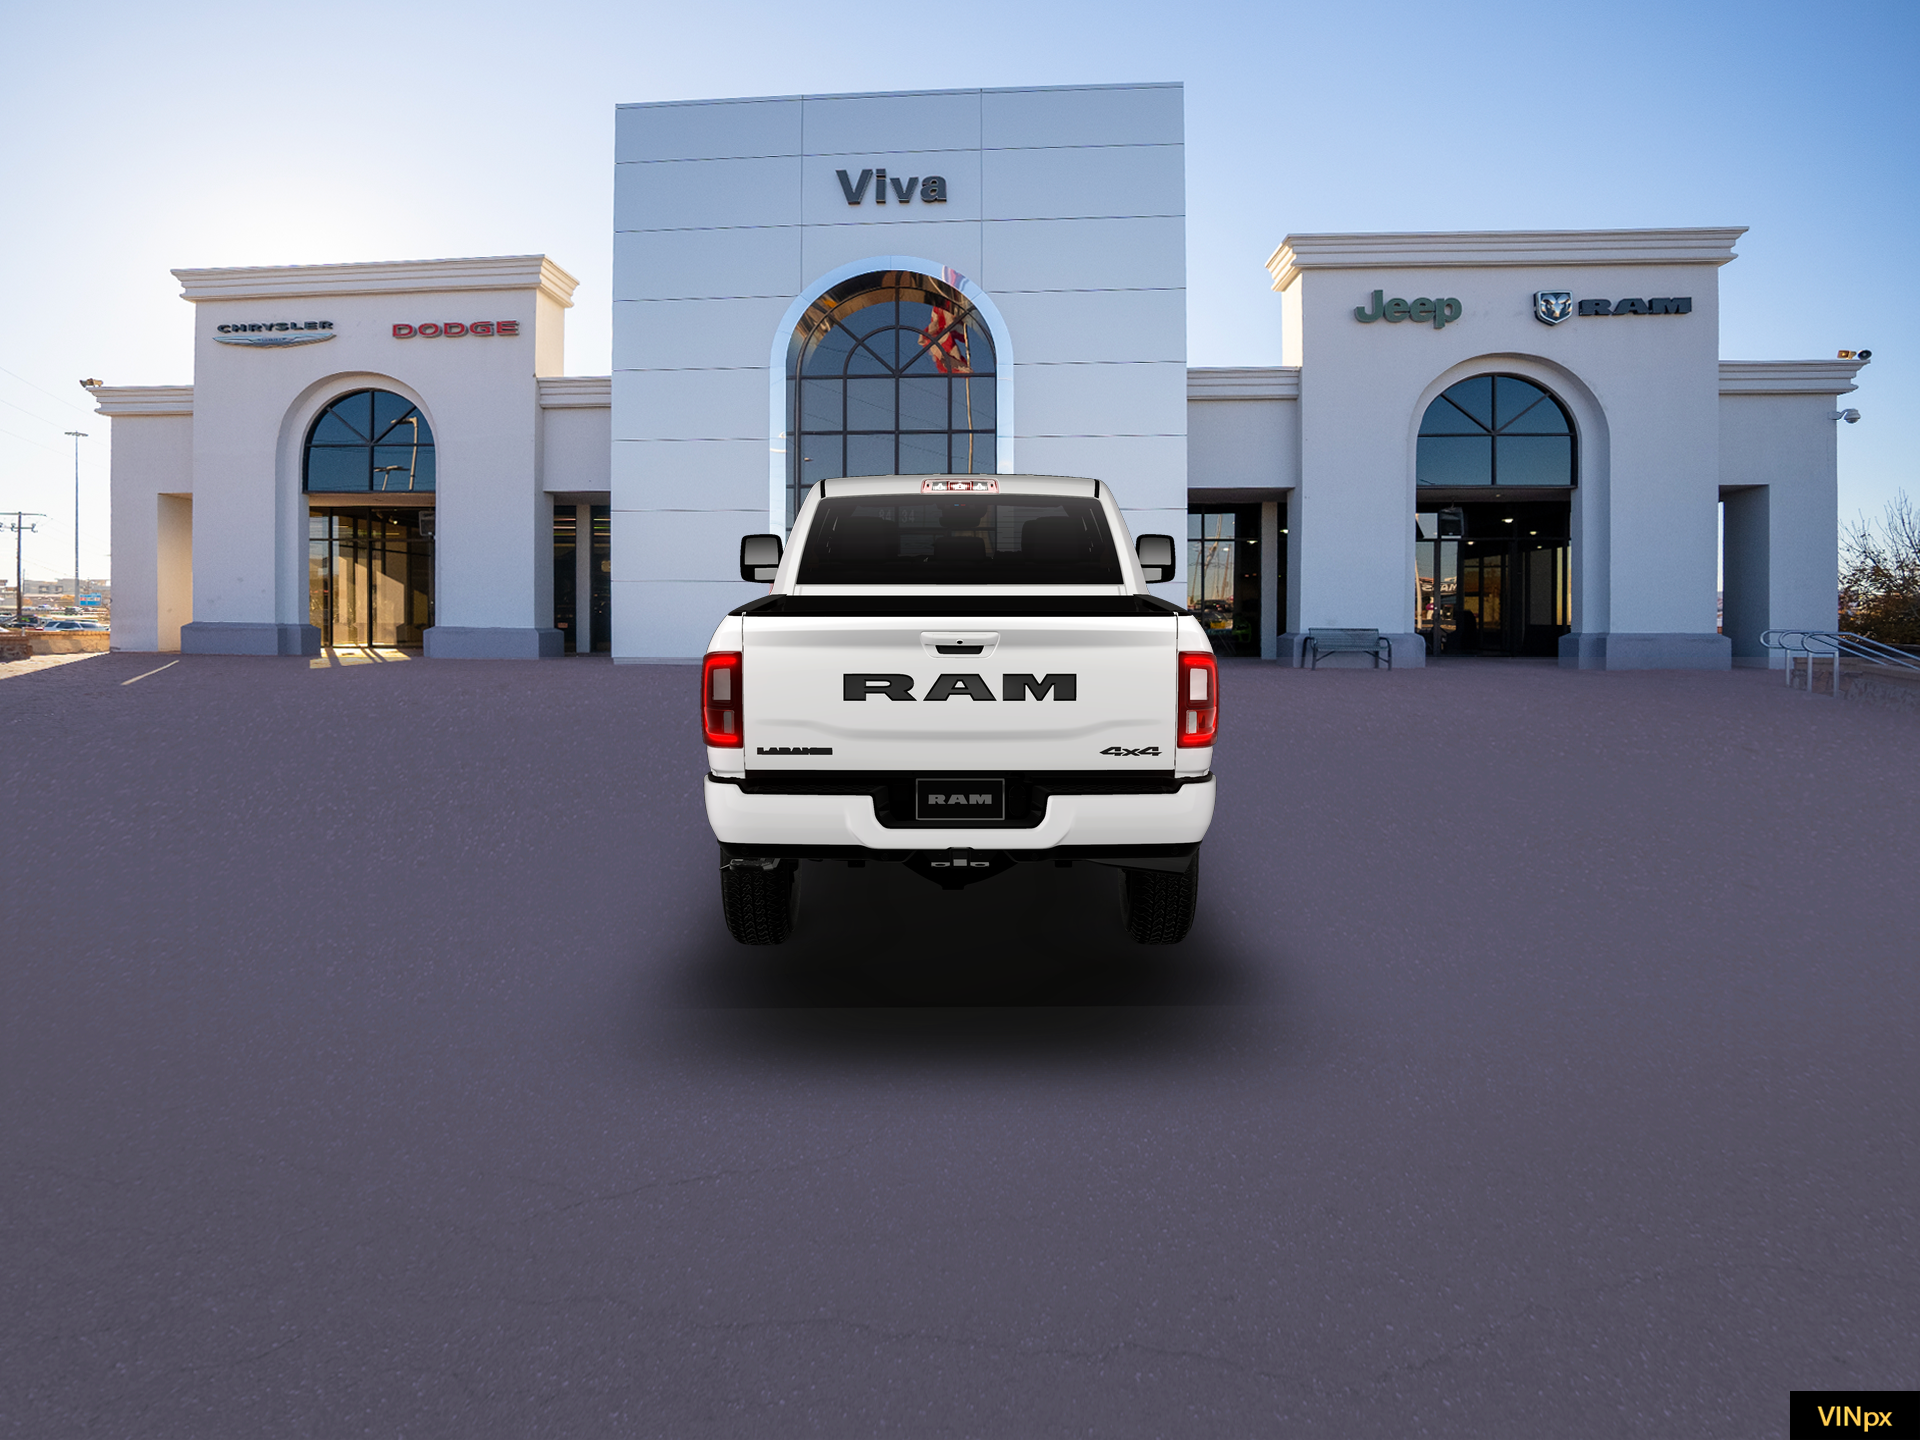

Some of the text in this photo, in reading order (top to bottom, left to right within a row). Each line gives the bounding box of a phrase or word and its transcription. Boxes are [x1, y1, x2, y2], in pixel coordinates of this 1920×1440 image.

[836, 169, 947, 205] Viva
[1354, 289, 1462, 329] Jeep
[1578, 296, 1692, 317] RAM
[216, 320, 335, 334] CHRYSLER
[392, 320, 520, 340] DODGE
[843, 674, 1077, 701] RAM
[927, 794, 993, 806] RAM
